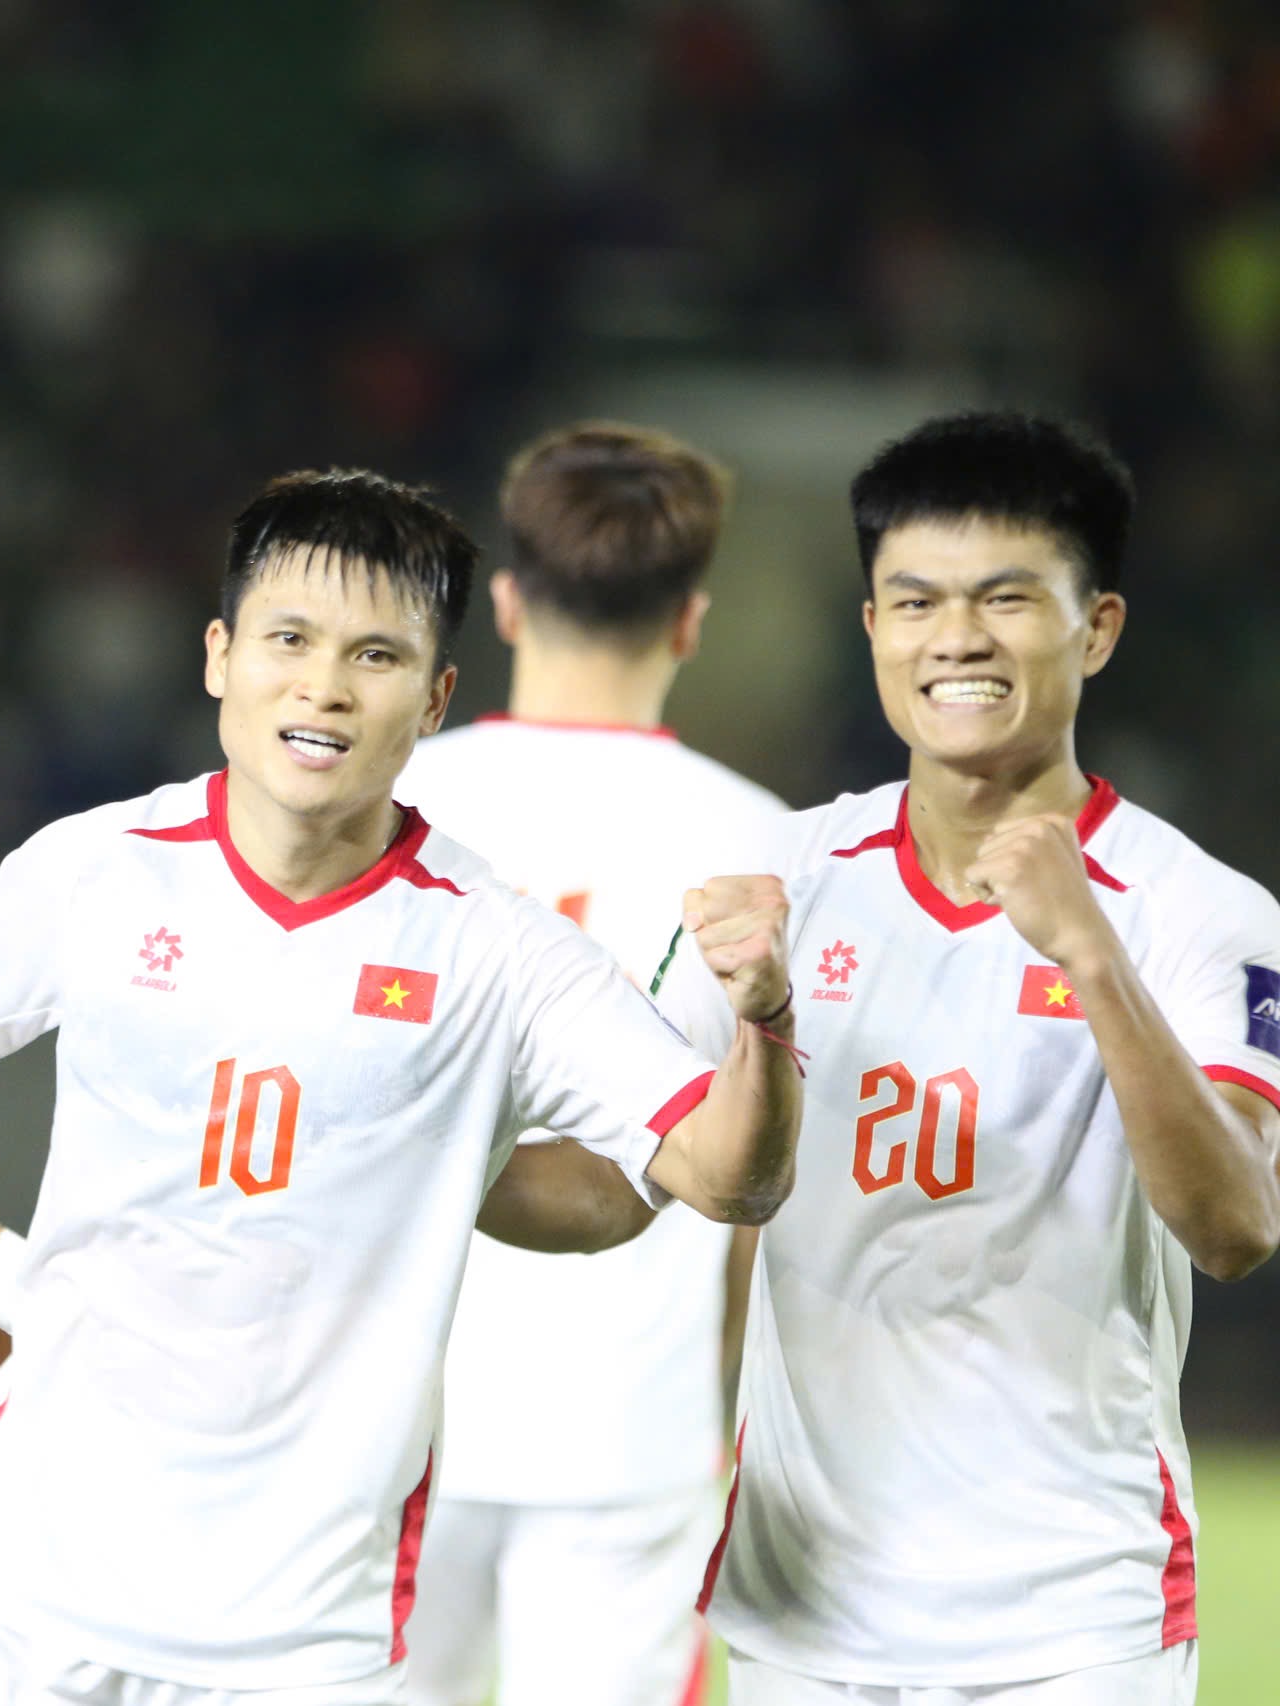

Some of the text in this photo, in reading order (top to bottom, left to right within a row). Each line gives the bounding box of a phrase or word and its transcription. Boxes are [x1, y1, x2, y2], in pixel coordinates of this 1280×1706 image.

[1252, 997, 1280, 1021] A
[198, 1057, 302, 1198] 10
[851, 1060, 980, 1201] 20
